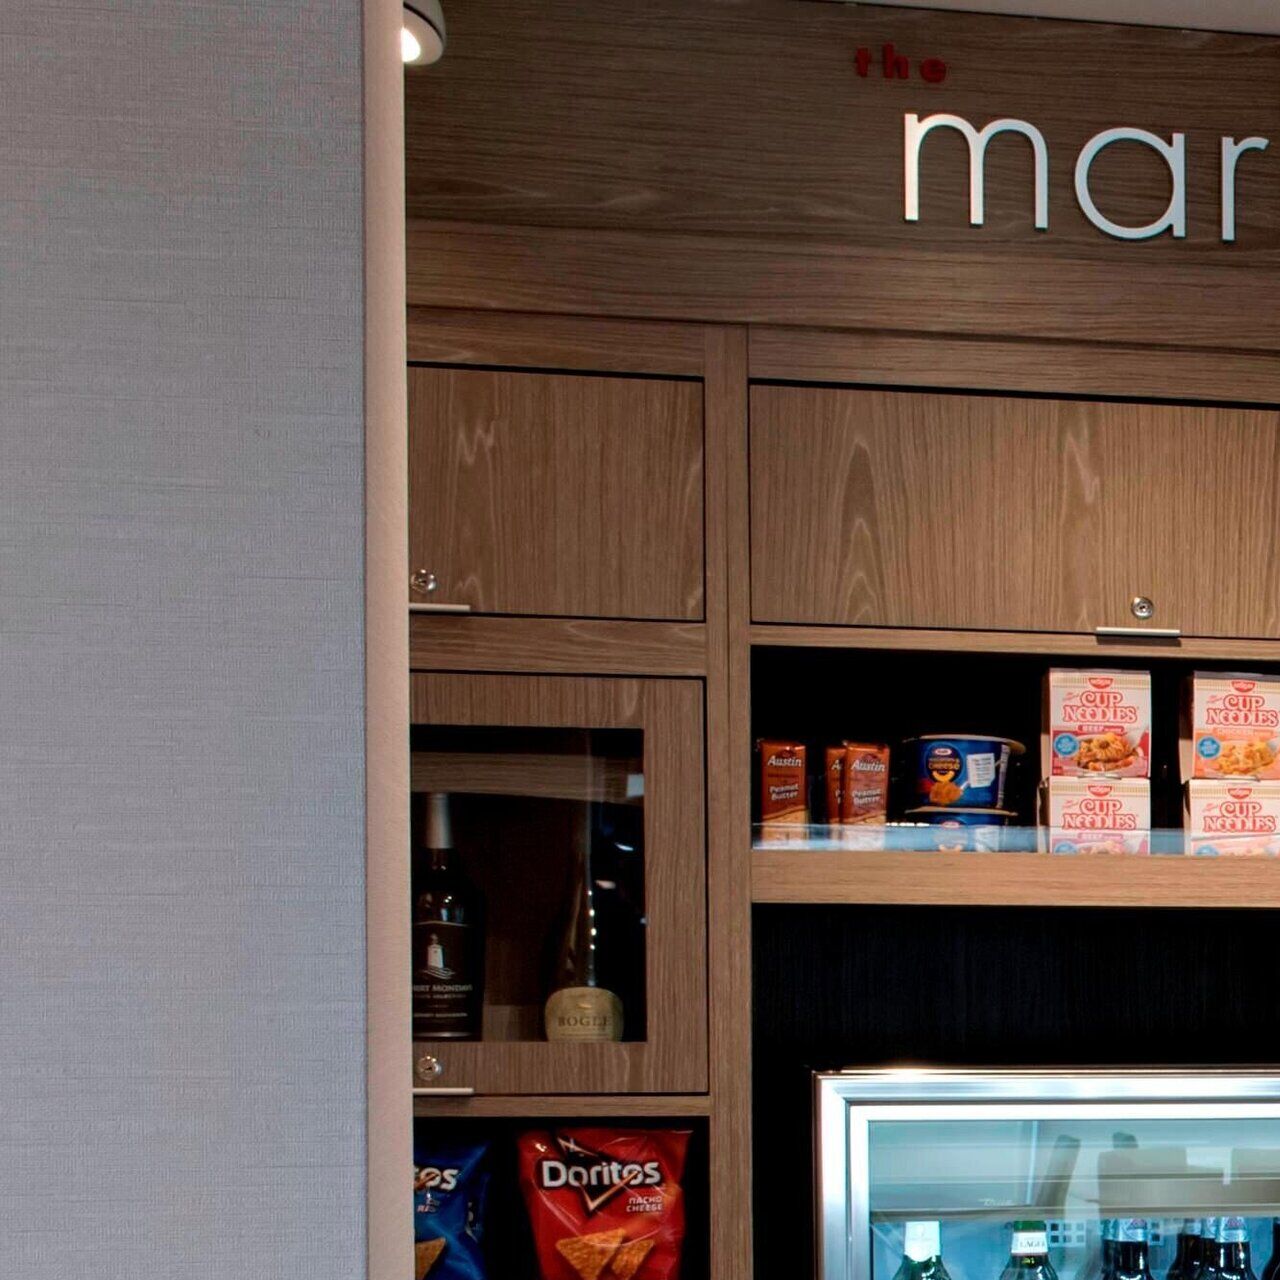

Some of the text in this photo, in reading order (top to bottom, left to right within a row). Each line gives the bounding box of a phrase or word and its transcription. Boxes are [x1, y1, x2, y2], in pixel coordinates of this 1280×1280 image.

[855, 43, 946, 83] the
[1081, 690, 1123, 708] CUP
[1223, 694, 1265, 710] CUP
[1063, 705, 1138, 723] NOODLES
[1206, 708, 1279, 727] NOODLES
[767, 755, 802, 767] Austin
[851, 760, 885, 772] Austin
[1079, 799, 1123, 815] CUP
[1219, 801, 1262, 817] CUP
[1062, 813, 1138, 831] NOODLES
[1203, 815, 1277, 833] NOODLES
[558, 1015, 608, 1027] BOGLE
[541, 1160, 662, 1188] Doritos
